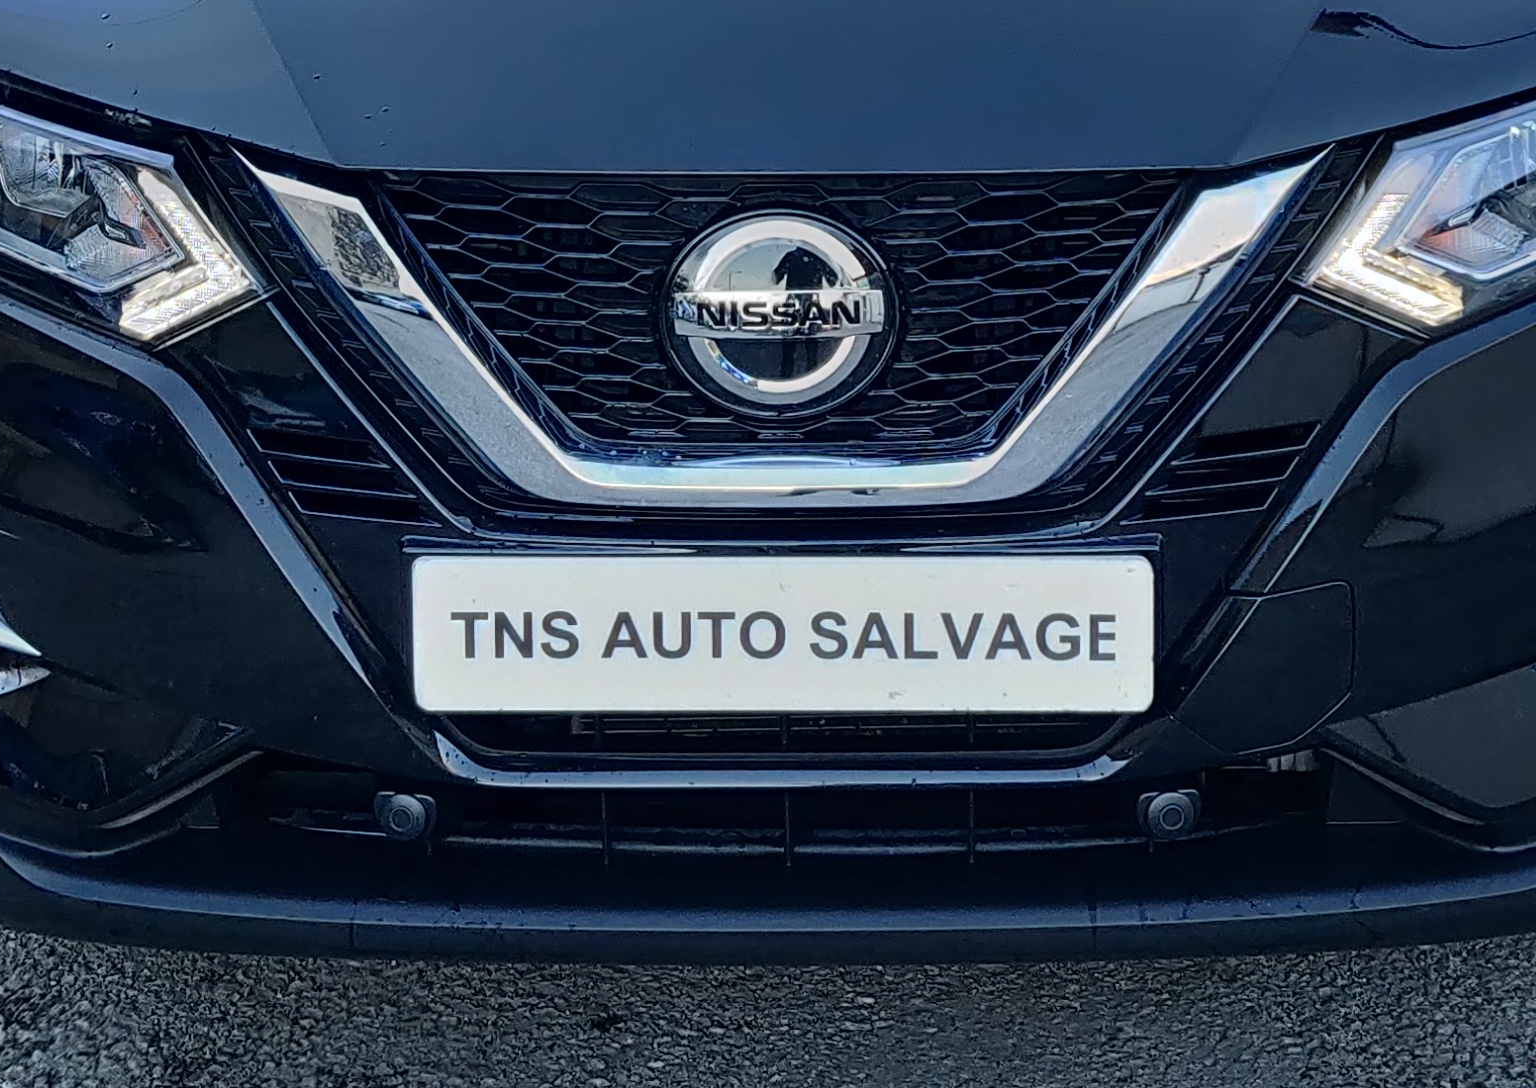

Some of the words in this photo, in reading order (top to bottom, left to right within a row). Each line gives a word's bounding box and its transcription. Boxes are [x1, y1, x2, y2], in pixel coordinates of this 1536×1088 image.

[696, 299, 862, 329] NISSAN
[450, 610, 579, 660] TNS
[601, 610, 787, 661] AUTO
[809, 611, 1117, 662] SALVAGE
